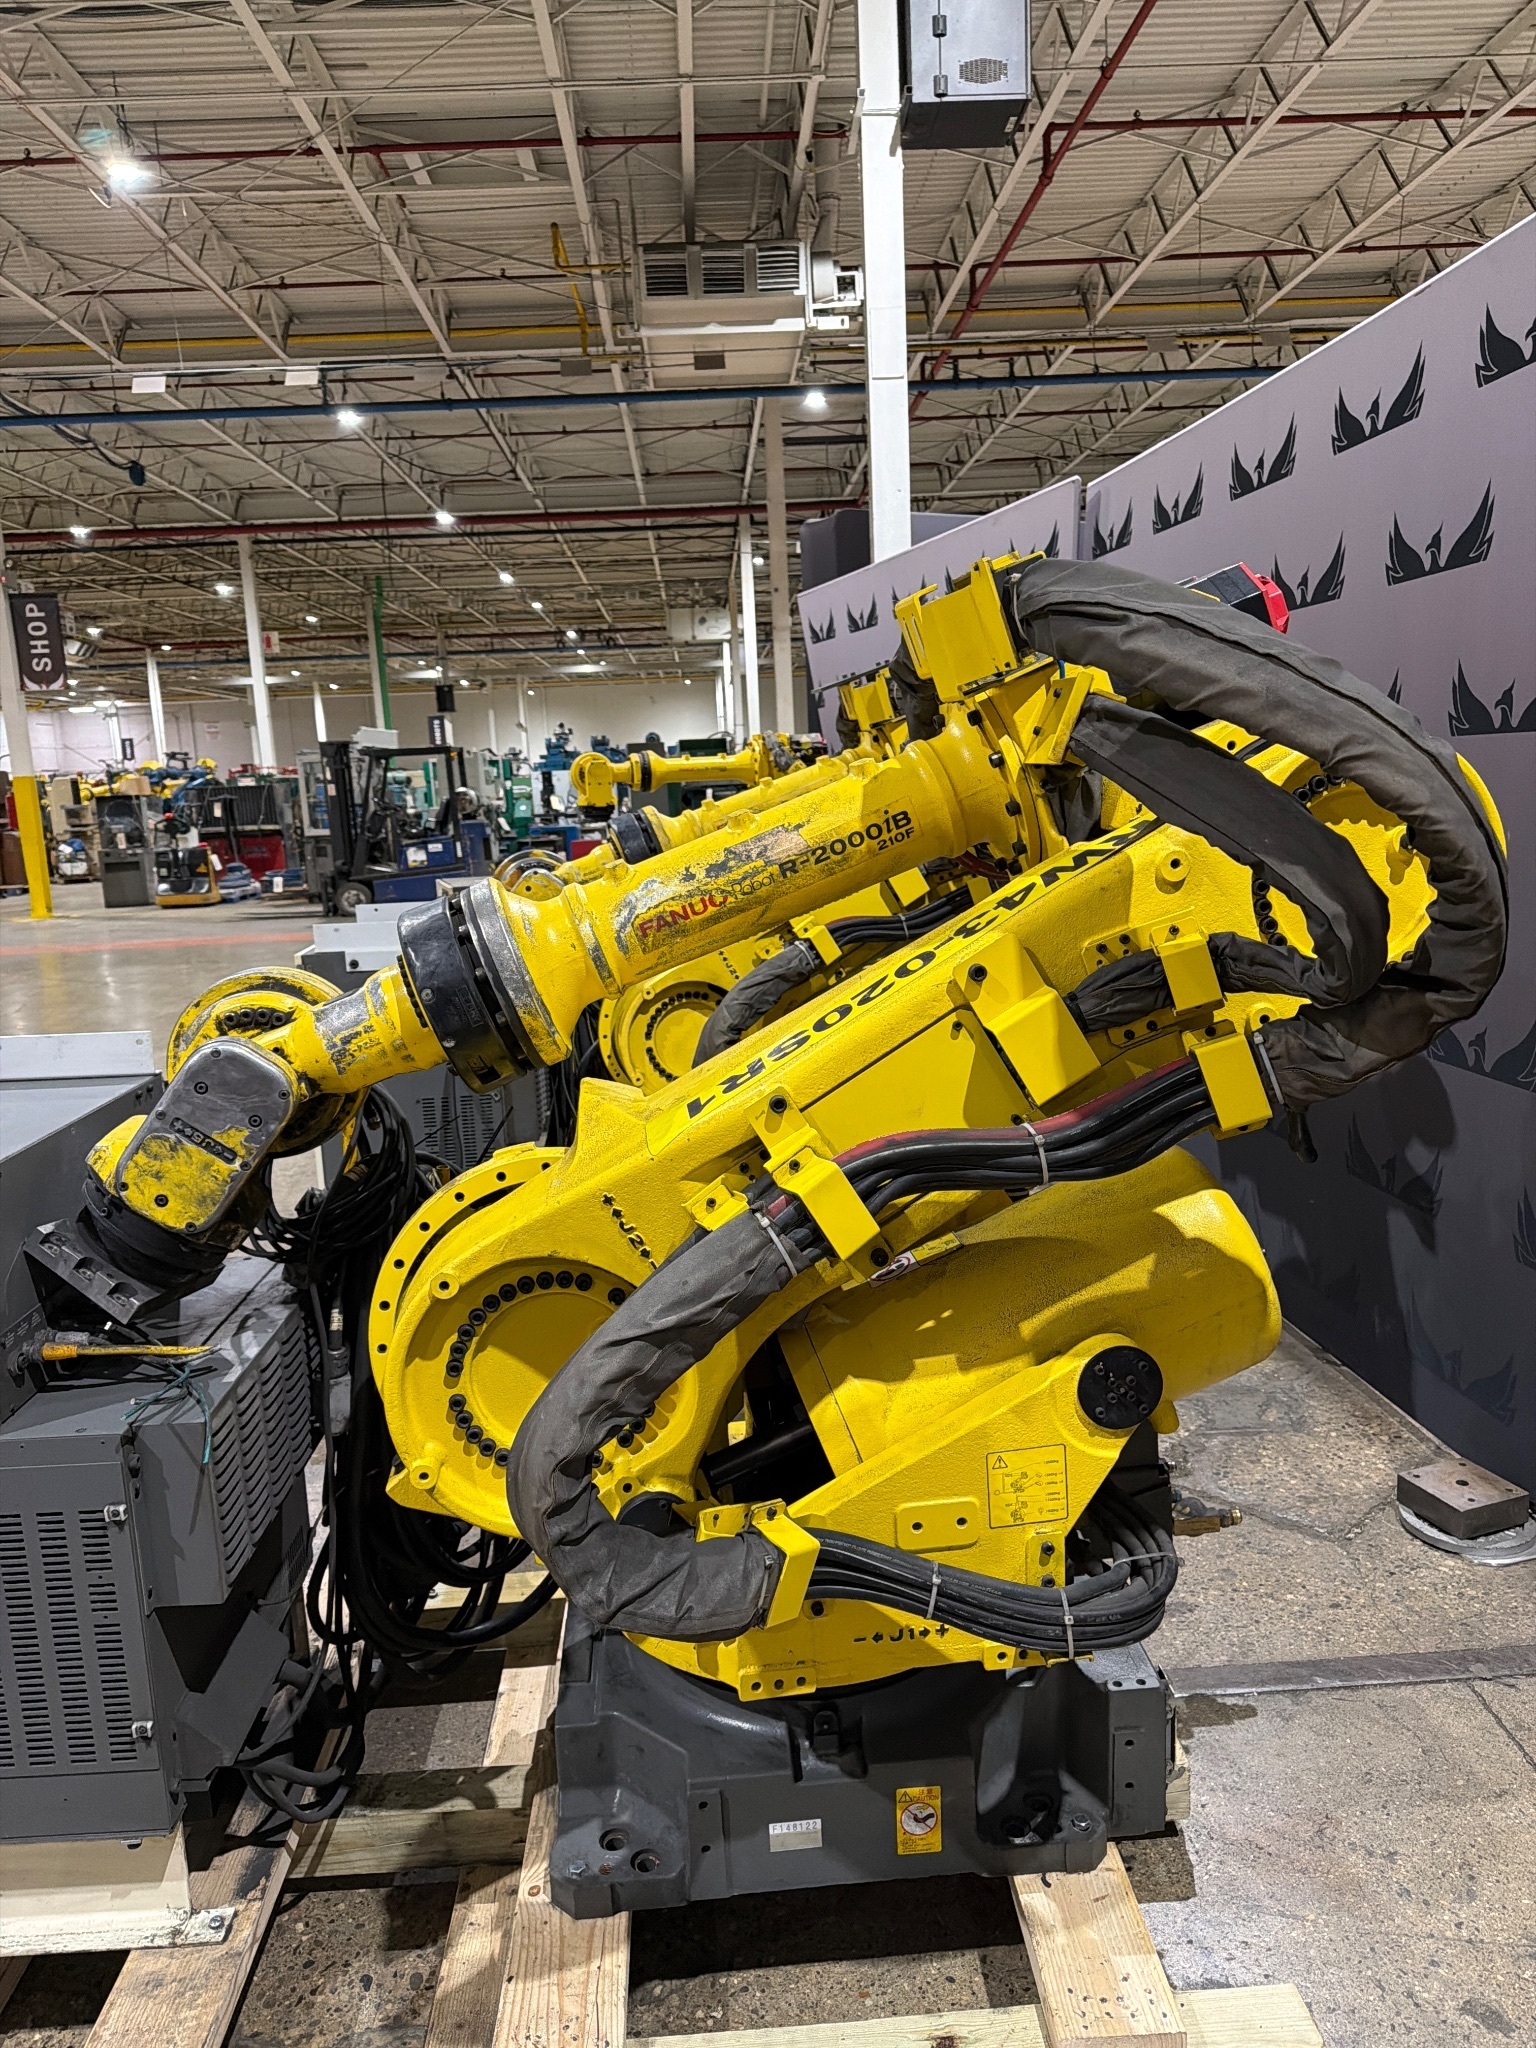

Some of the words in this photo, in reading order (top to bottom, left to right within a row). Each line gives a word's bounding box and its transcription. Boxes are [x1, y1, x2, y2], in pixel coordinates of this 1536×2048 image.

[25, 603, 52, 672] SHOP
[877, 826, 915, 851] 210F
[638, 894, 729, 939] FANUC
[779, 809, 913, 879] R-2000iB
